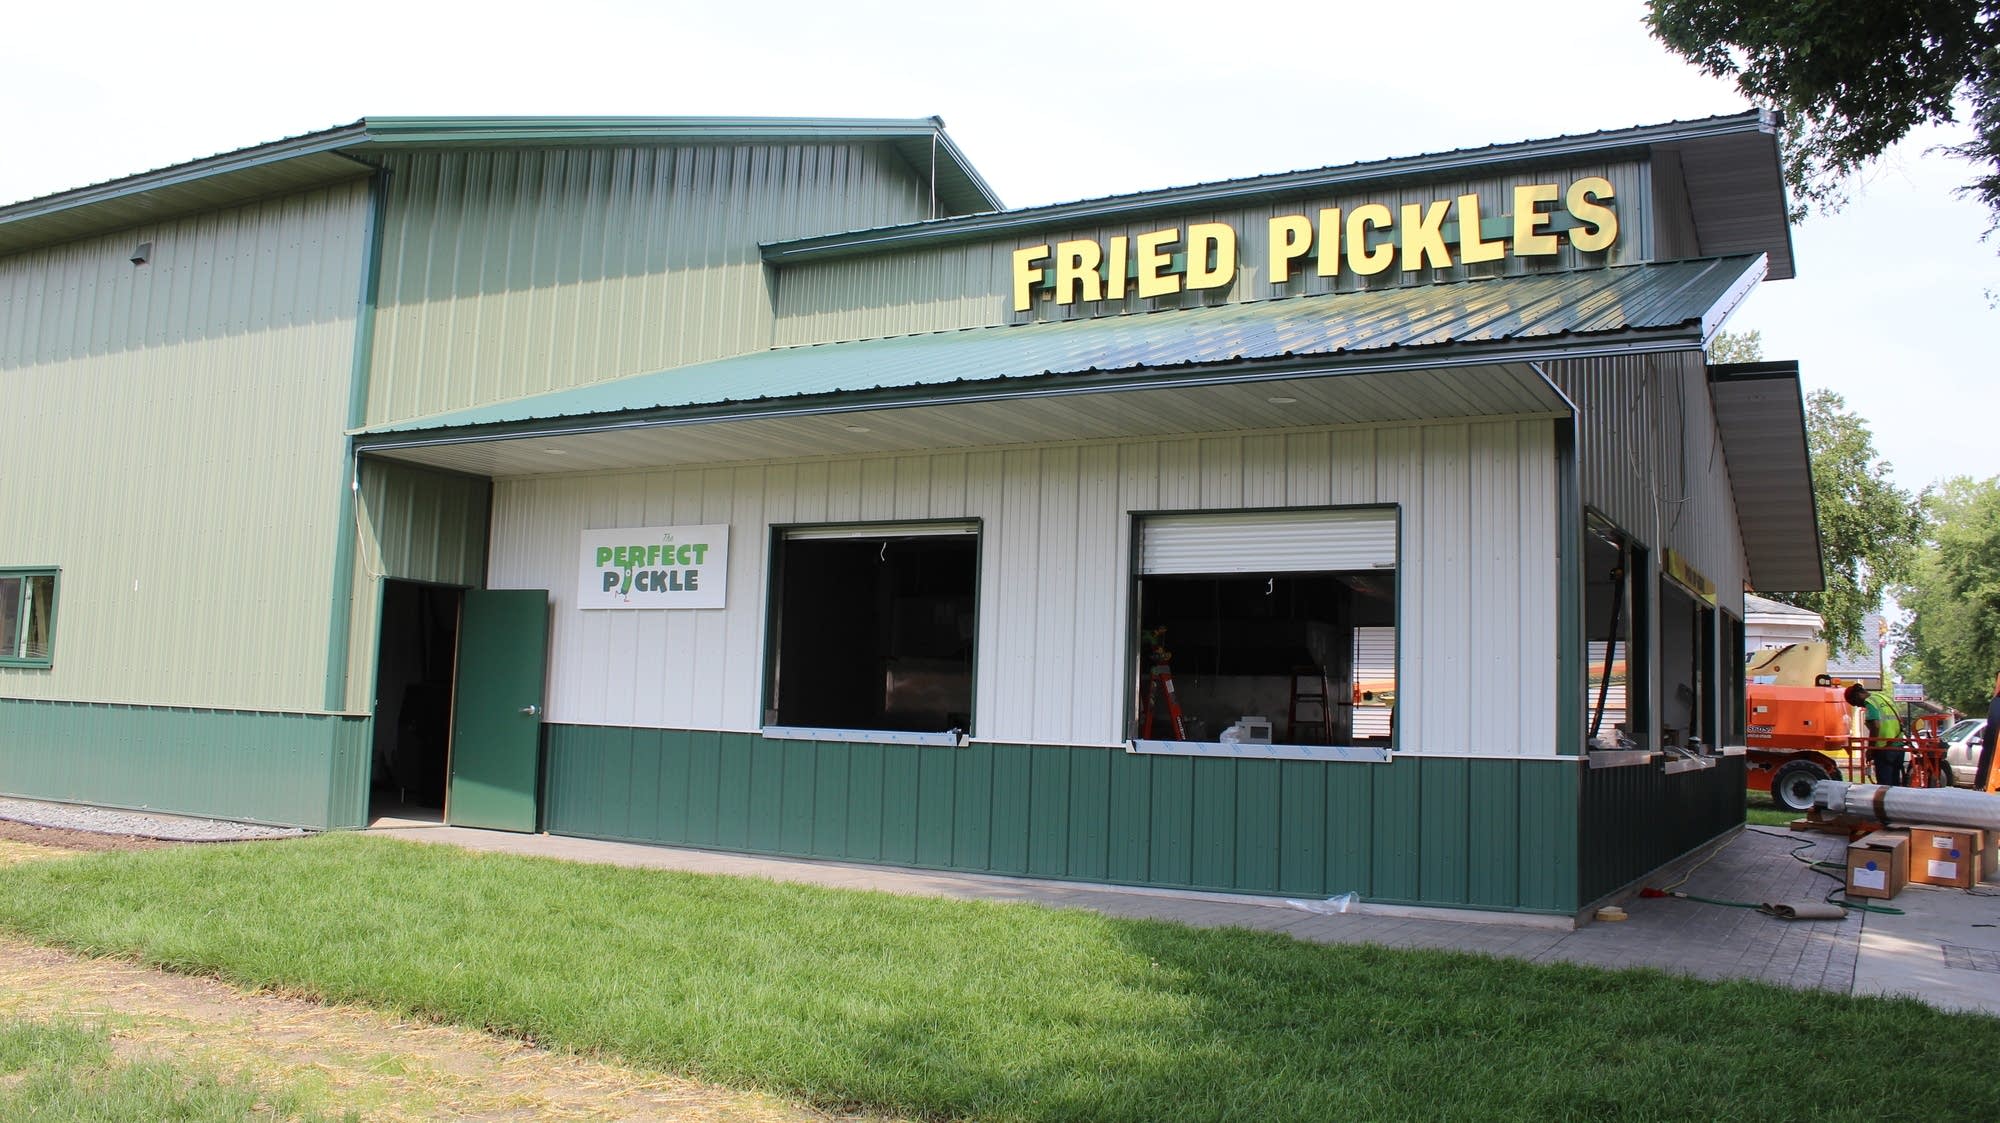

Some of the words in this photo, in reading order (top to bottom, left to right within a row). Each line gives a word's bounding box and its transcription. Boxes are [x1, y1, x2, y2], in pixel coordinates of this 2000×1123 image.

[1012, 221, 1236, 312] FRIED
[1268, 175, 1619, 284] PICKLES
[596, 543, 709, 568] PERFECT
[603, 565, 699, 596] PICKLE
